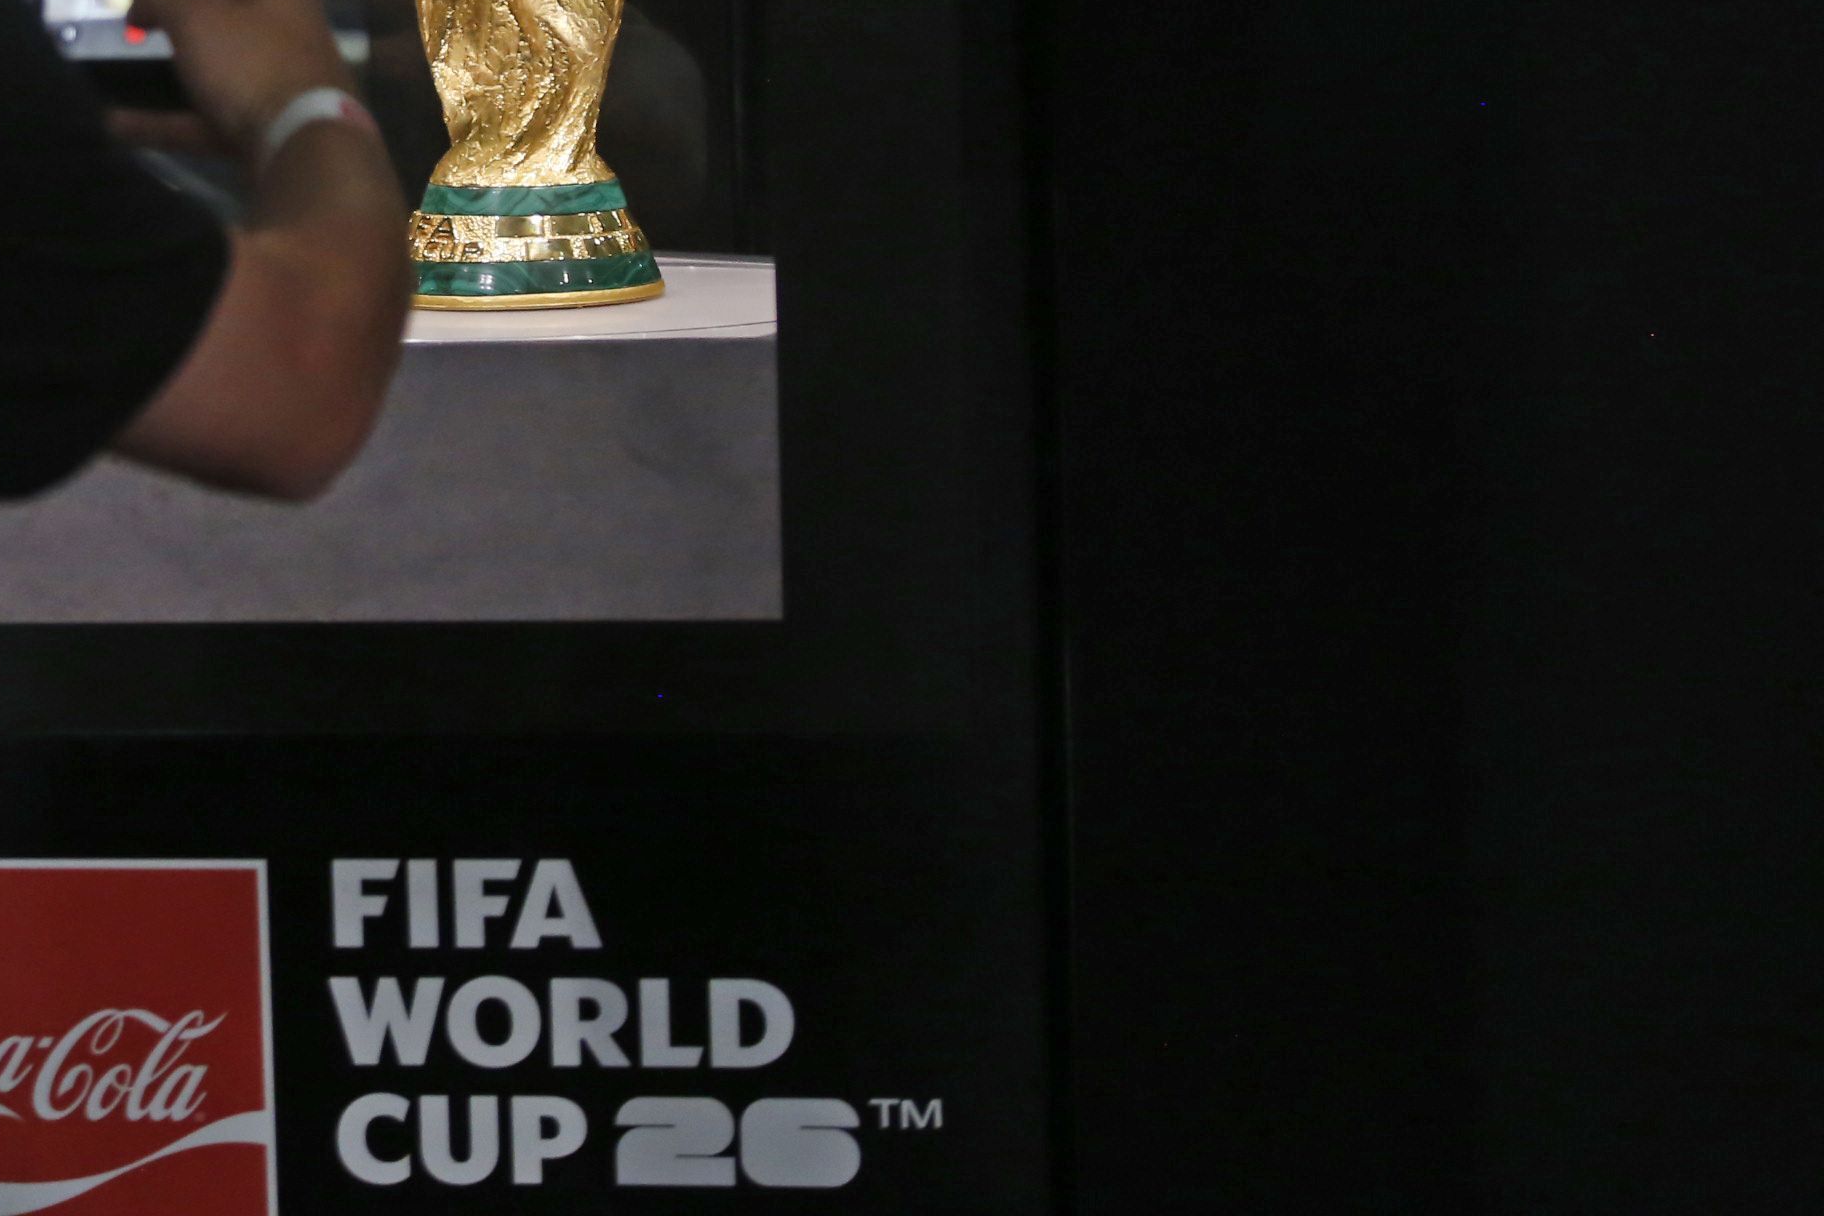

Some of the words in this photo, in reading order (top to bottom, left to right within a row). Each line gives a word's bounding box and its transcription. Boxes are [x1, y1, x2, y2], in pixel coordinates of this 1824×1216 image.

[333, 858, 602, 949] FIFA
[329, 975, 795, 1069] WORLD
[337, 1092, 588, 1186] CUP
